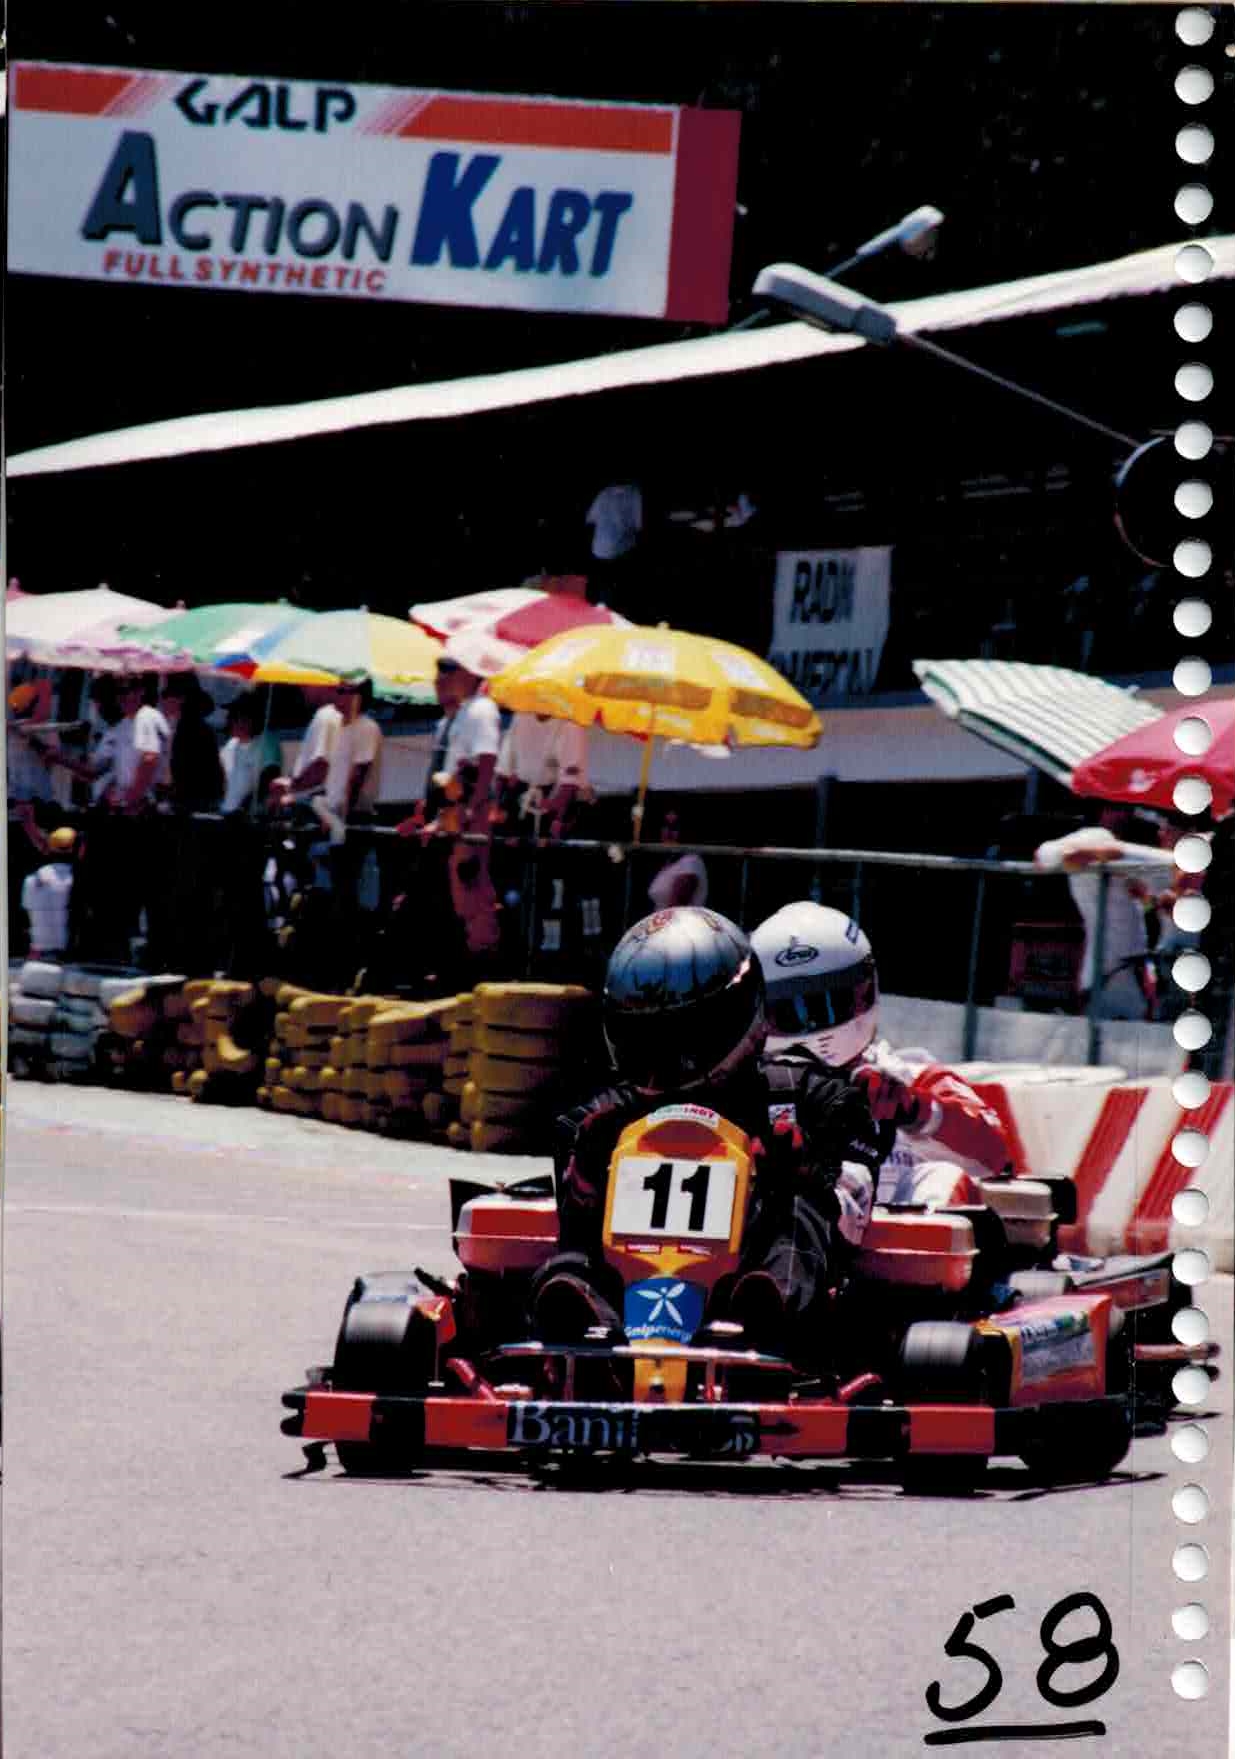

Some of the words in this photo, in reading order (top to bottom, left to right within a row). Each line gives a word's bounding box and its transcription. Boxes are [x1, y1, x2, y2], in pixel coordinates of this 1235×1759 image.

[173, 79, 357, 132] GALP
[81, 129, 400, 263] ACTION
[409, 151, 635, 276] KART
[104, 251, 187, 281] FULL
[195, 257, 388, 292] SYNTHETIC
[643, 1162, 711, 1232] 11
[925, 1592, 1120, 1722] 58
